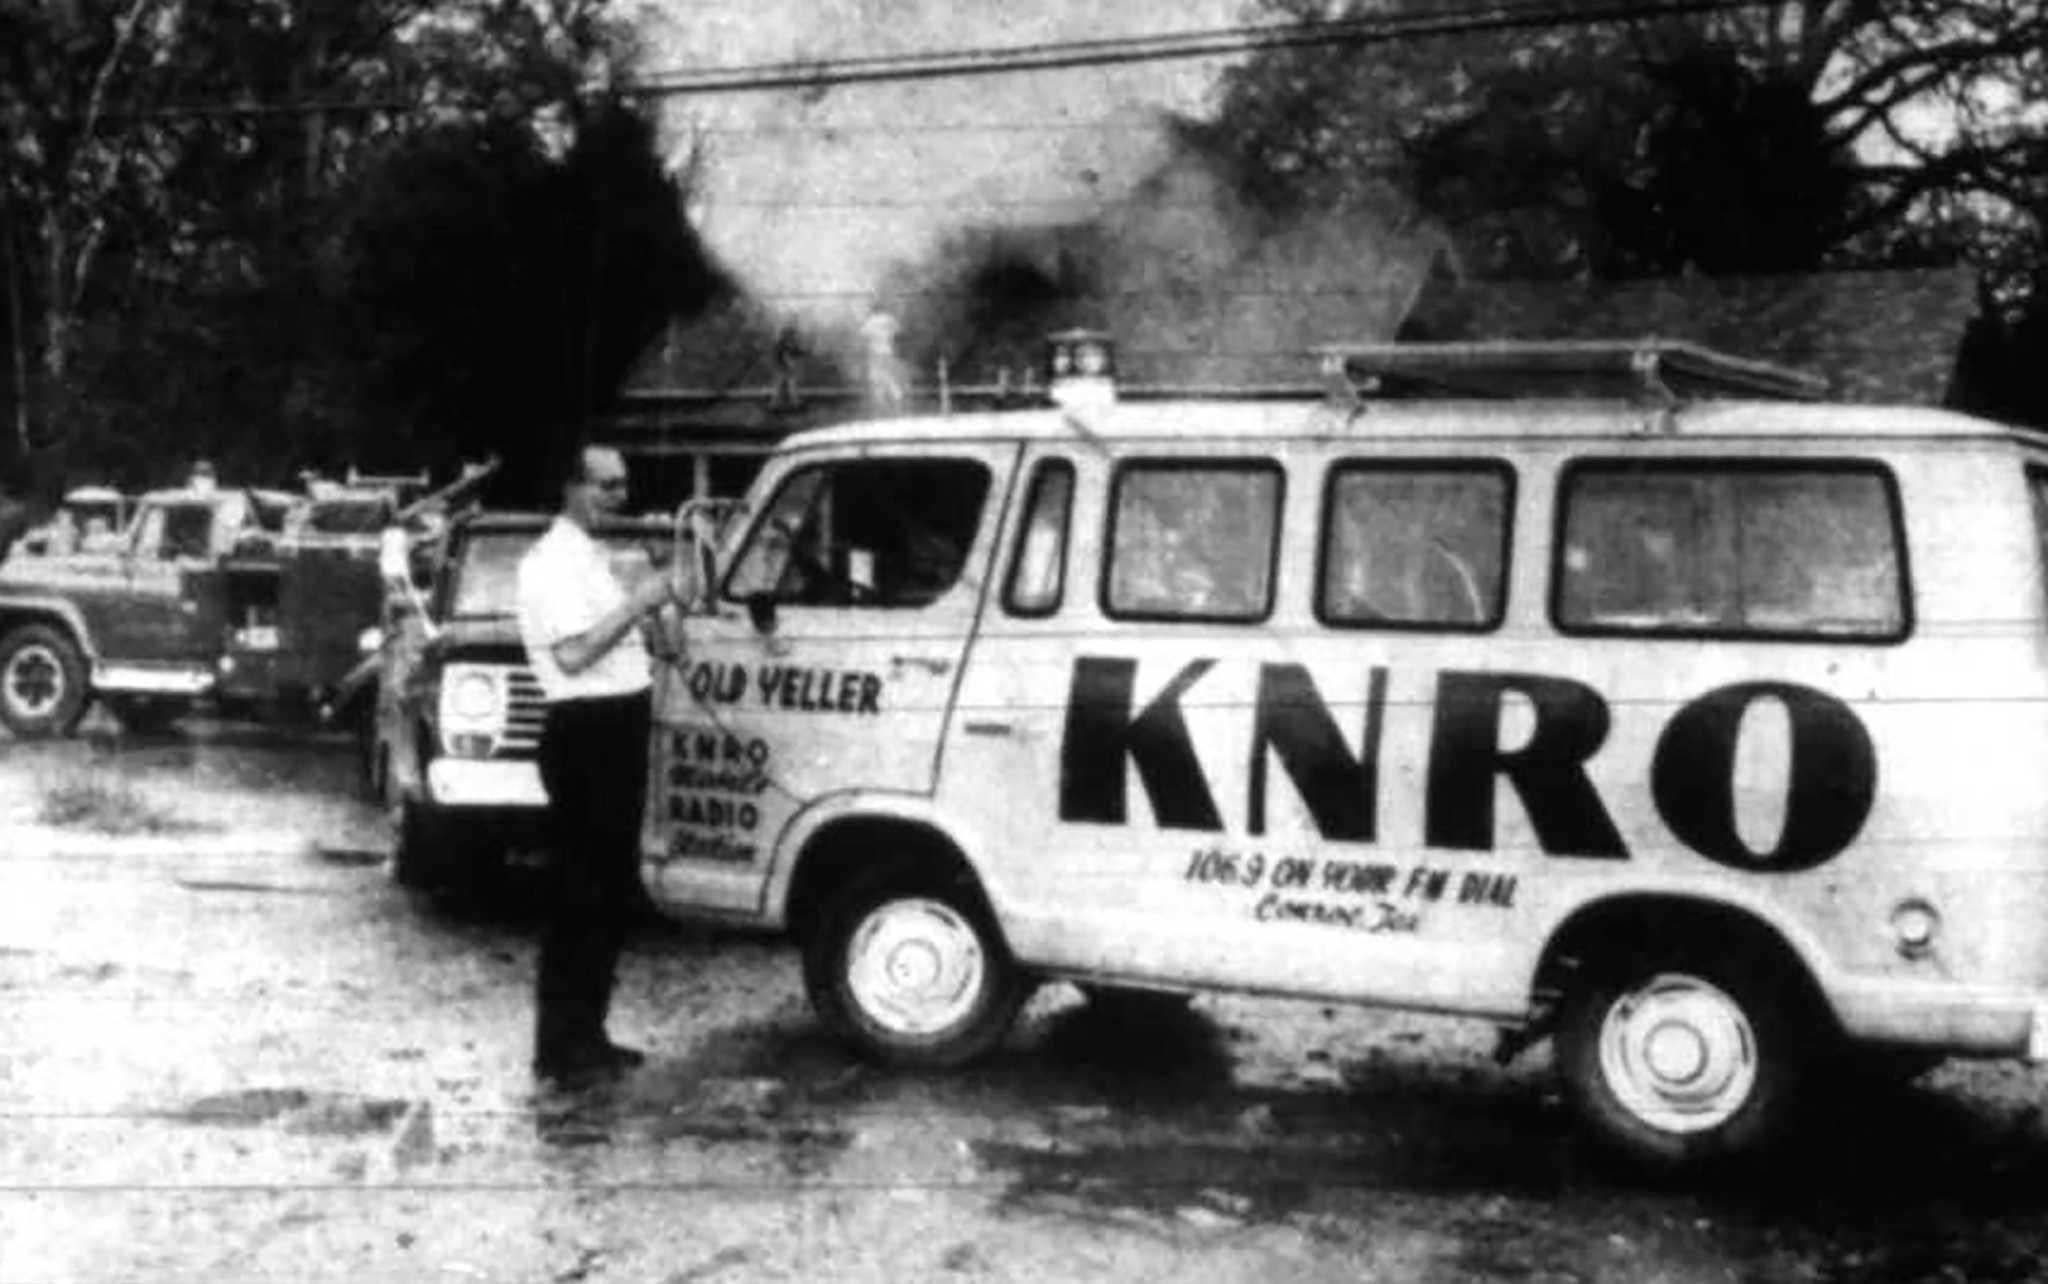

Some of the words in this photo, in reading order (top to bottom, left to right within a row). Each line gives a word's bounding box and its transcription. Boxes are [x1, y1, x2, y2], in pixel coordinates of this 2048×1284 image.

[690, 663, 747, 703] OLD
[758, 666, 882, 715] YELLER
[672, 732, 769, 768] KNRO
[1058, 655, 1878, 873] KNRO
[669, 795, 758, 831] RADIO
[1271, 857, 1317, 887] ON
[1322, 860, 1399, 893] YOUR
[1404, 866, 1450, 901] FM
[1458, 871, 1519, 907] DIAL
